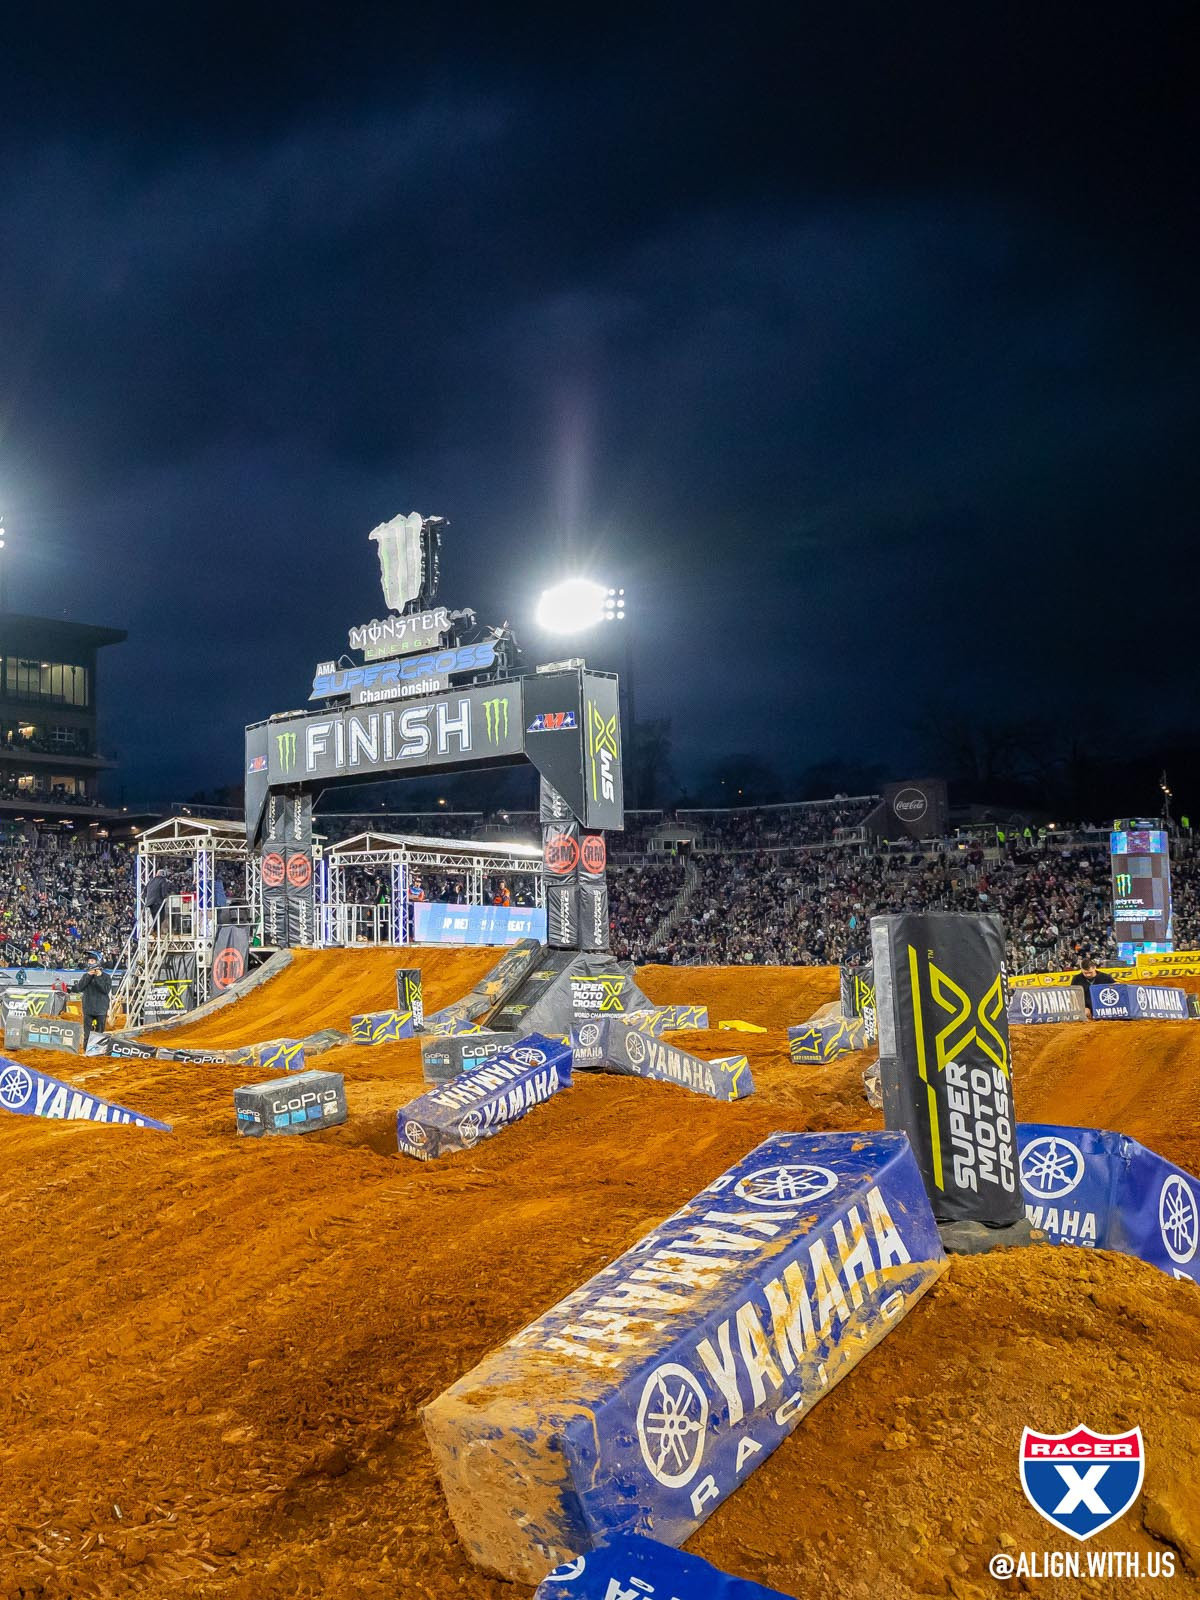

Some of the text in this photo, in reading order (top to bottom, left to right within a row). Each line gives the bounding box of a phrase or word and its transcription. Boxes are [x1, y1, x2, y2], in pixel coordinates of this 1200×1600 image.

[351, 611, 449, 645] MONSTER
[367, 638, 433, 657] ENERGY
[309, 643, 497, 699] SUPERCROSS
[317, 664, 336, 676] AMA
[360, 678, 440, 704] Championship
[527, 712, 578, 733] AMA
[305, 698, 473, 772] FINISH
[1158, 966, 1200, 976] DUN
[571, 982, 604, 992] SUPER
[573, 991, 603, 1000] MOTO
[572, 1000, 604, 1008] CROSS
[1033, 991, 1081, 1015] YAMAHA
[1095, 1006, 1129, 1017] YAMAHA
[1146, 988, 1184, 1012] YAMAHA
[29, 1023, 74, 1037] GoPro
[1025, 1014, 1081, 1024] RACING
[112, 1043, 151, 1059] GoPro
[462, 1043, 515, 1058] GoPro
[572, 1047, 603, 1060] YAMAHA
[646, 1040, 717, 1096] YAMAHA
[431, 1059, 529, 1110] YAMAHA
[483, 1065, 560, 1128] YAMAHA
[237, 1108, 260, 1117] GoPro
[273, 1090, 337, 1114] GoPro
[945, 1061, 979, 1193] SUPER
[970, 1068, 999, 1184] MOTO
[993, 1066, 1015, 1193] CROSS
[1025, 1204, 1097, 1240] MAHA
[543, 1211, 799, 1368] YAMAHA
[696, 1186, 911, 1427] YAMAHA
